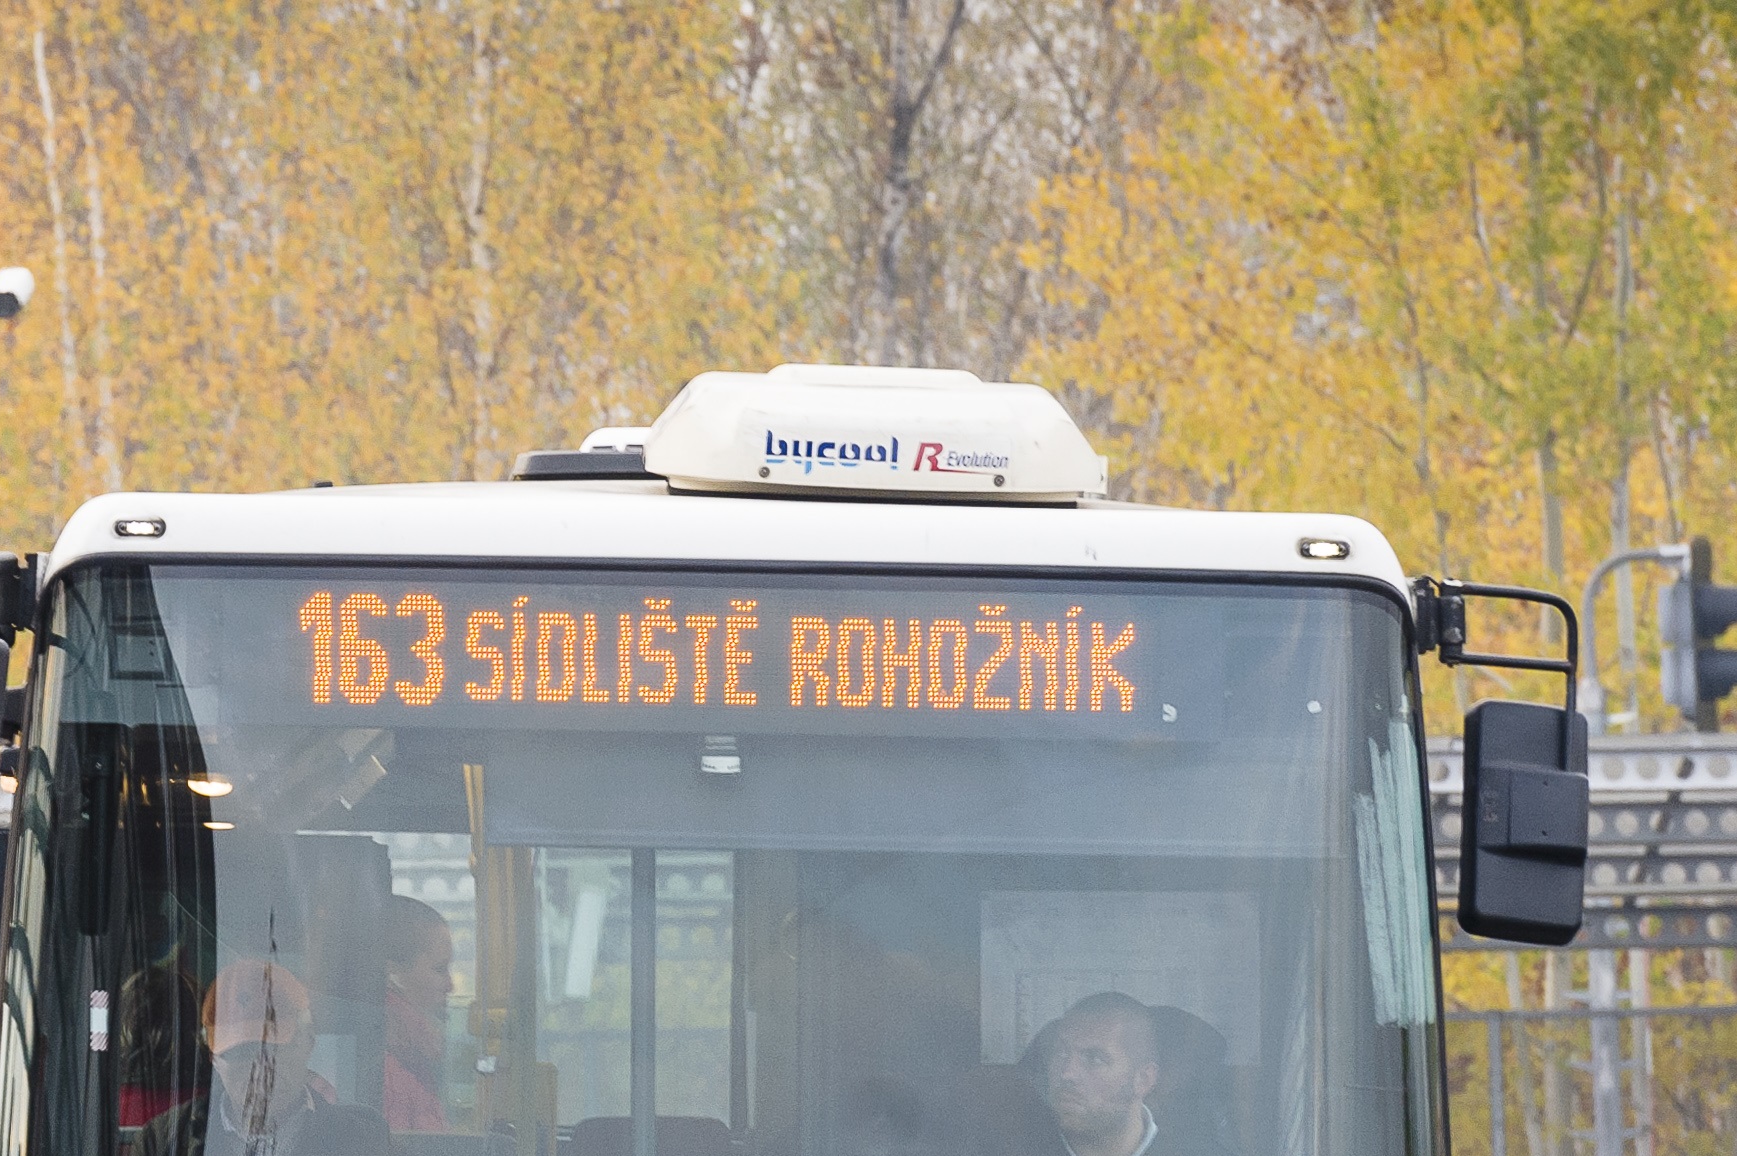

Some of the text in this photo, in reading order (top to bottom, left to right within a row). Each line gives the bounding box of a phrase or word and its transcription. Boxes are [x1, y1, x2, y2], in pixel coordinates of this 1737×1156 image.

[765, 429, 899, 475] bycool
[946, 450, 1009, 469] Evolution
[300, 591, 1136, 712] 163 SÍDLIŠTĚ ROHOŽNÍK
